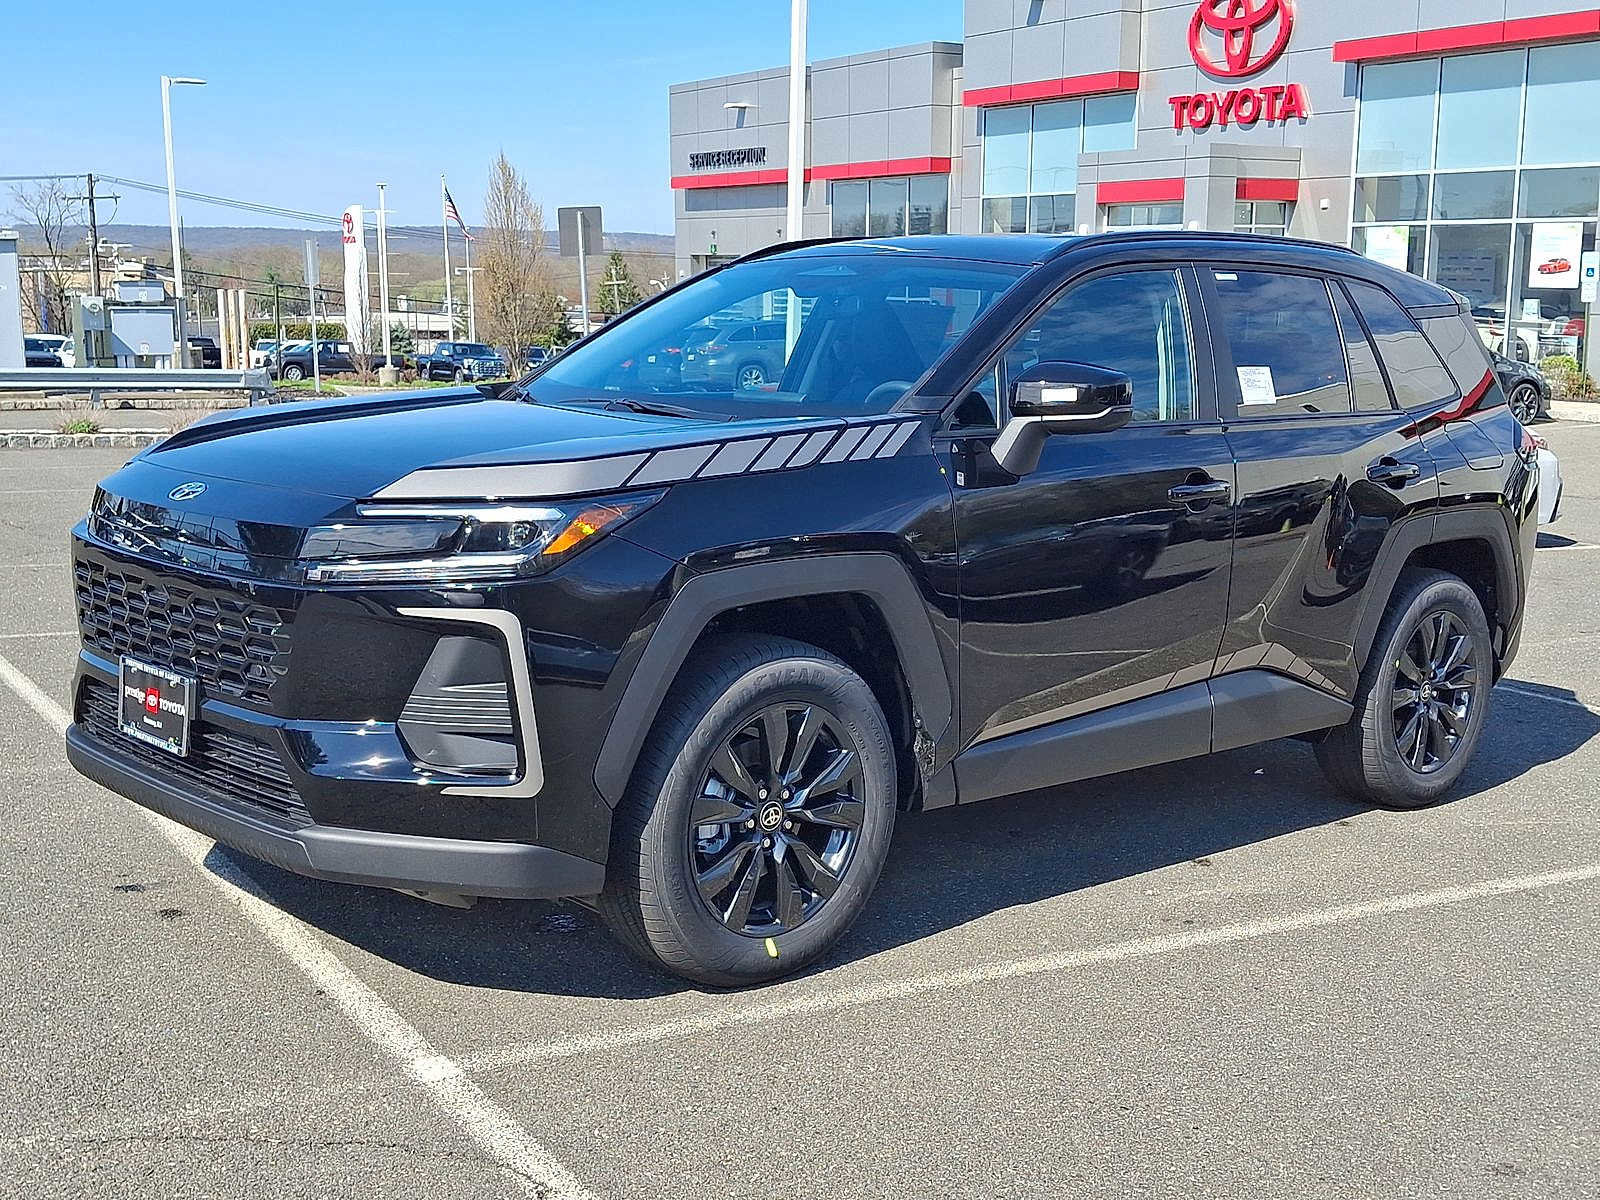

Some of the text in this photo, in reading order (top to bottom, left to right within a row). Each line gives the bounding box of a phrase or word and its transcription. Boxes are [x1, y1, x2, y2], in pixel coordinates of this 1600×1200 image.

[1169, 84, 1308, 129] TOYOTA
[690, 146, 766, 168] SERVICE RECEPTION
[159, 698, 185, 716] TOYOTA
